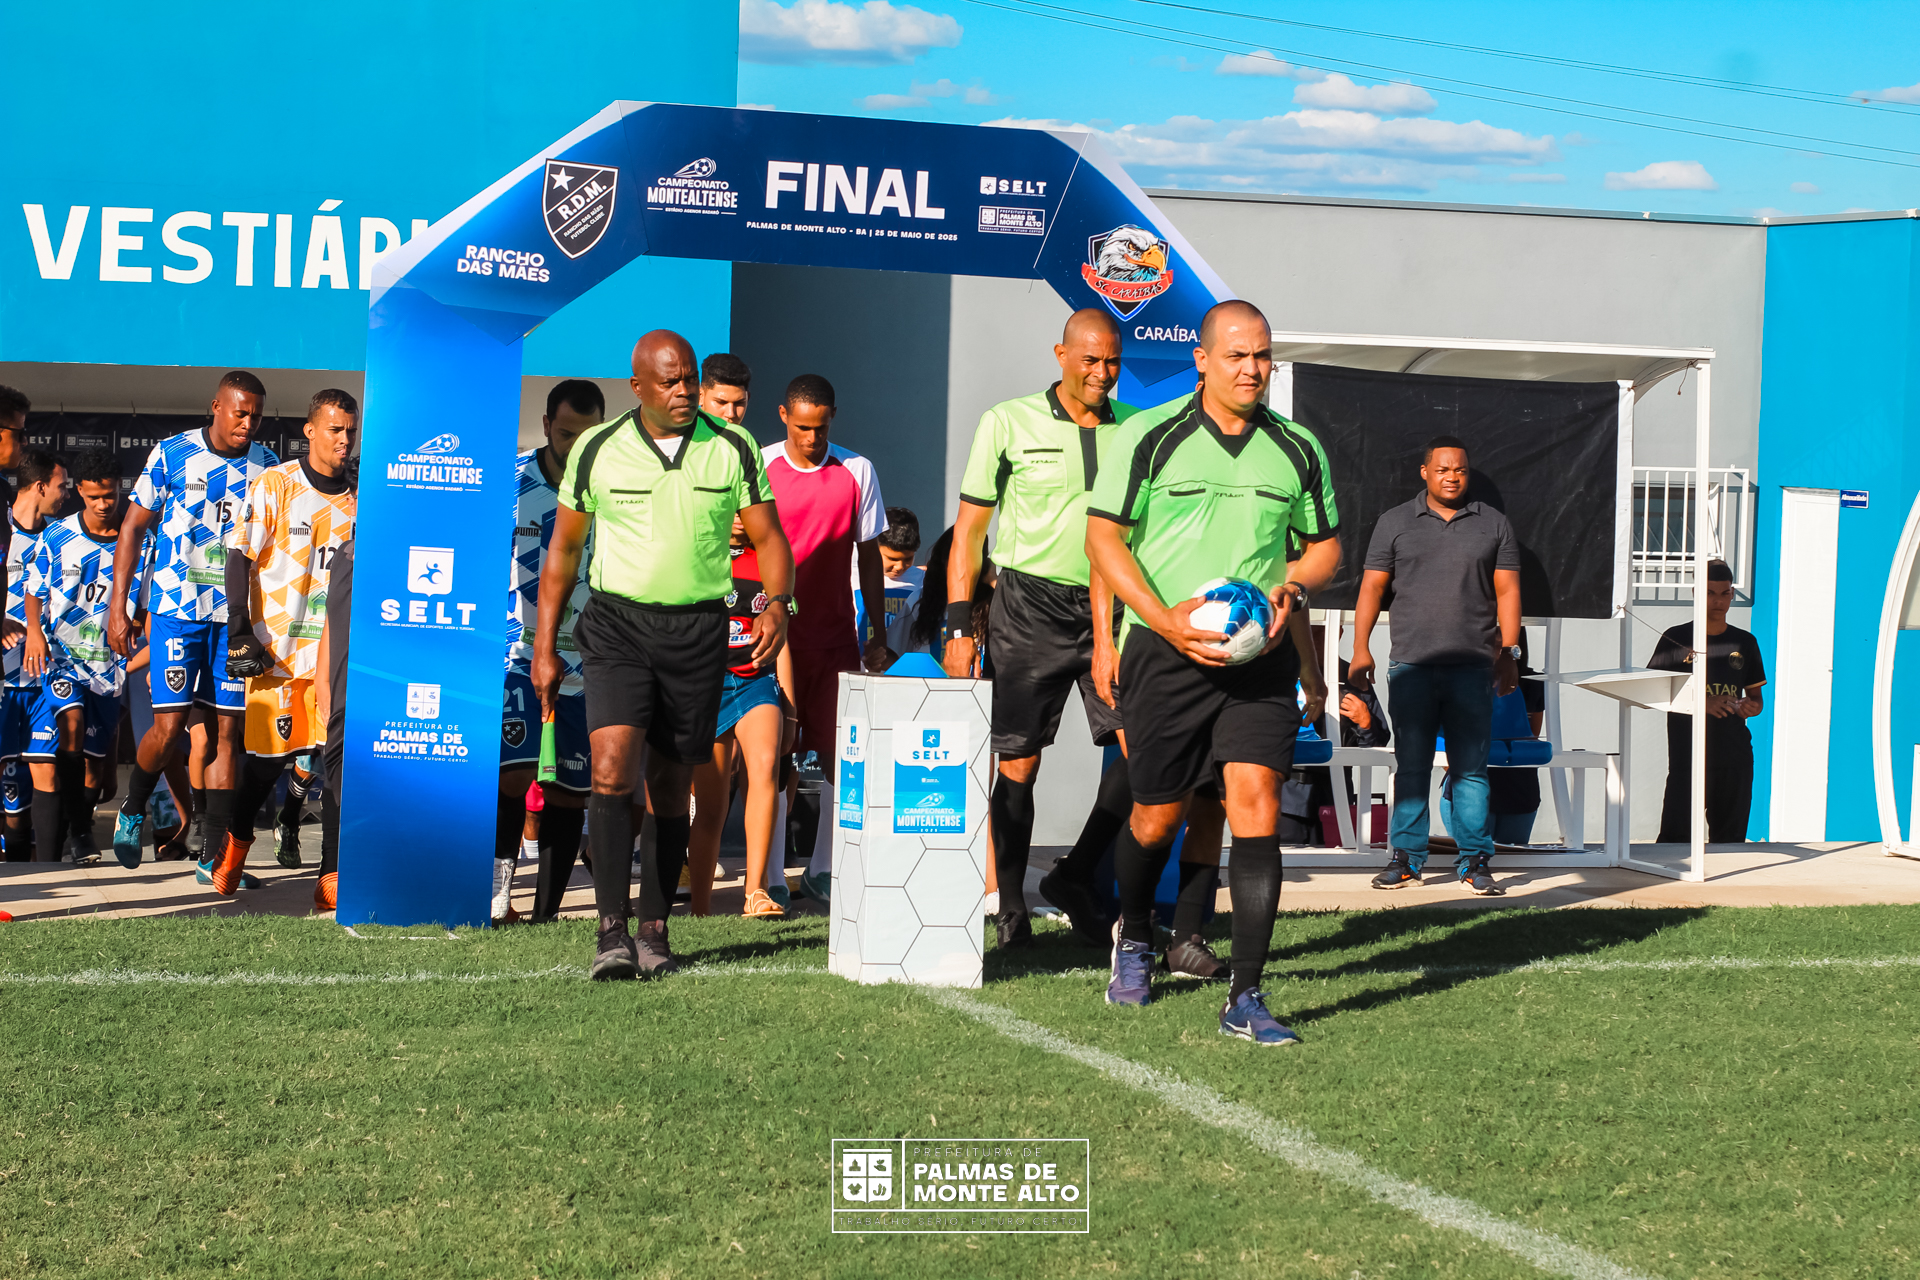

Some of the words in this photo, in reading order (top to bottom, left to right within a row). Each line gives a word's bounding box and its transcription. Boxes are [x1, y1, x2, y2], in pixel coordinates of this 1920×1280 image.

[658, 177, 729, 190] CAMPEONATO
[765, 160, 945, 219] FINAL
[998, 179, 1046, 194] SELT
[557, 180, 607, 220] R.D.M.
[647, 186, 738, 208] MONTEALTENSE
[564, 222, 582, 238] RANCHO
[581, 214, 592, 224] DAS
[570, 224, 590, 240] FUTEBOL
[590, 212, 605, 224] CLUBE
[746, 221, 778, 230] PALMAS
[794, 224, 824, 233] MONTE
[826, 226, 847, 234] ALTO
[900, 231, 922, 239] MAIO
[22, 199, 428, 290] VESTIÁR
[466, 244, 544, 267] RANCHO
[457, 258, 493, 275] DAS
[498, 264, 550, 282] MÃES
[1095, 280, 1110, 292] SC
[1134, 325, 1200, 342] CARAÍBA
[29, 436, 52, 445] ELT
[398, 453, 473, 466] CAMPEONATO
[387, 463, 483, 484] MONTEALTENSE
[216, 501, 232, 523] 15
[289, 527, 309, 535] PUMA
[515, 527, 539, 536] PUMA
[318, 546, 338, 569] 12
[86, 582, 107, 603] 07
[381, 599, 476, 625] SELT
[165, 638, 184, 661] 15
[221, 682, 244, 692] PUMA
[1706, 683, 1738, 698] ATAR
[274, 686, 292, 709] 12
[504, 687, 525, 712] 21
[385, 721, 442, 730] PREFEITURA
[32, 731, 52, 740] PUMA
[380, 730, 438, 743] PALMAS
[443, 733, 462, 744] DE
[373, 741, 428, 754] MONTE
[432, 745, 468, 757] ALTO
[847, 746, 859, 756] SELT
[912, 751, 950, 760] SELT
[558, 757, 583, 770] PUMA
[897, 815, 961, 826] MONTEALTENSE
